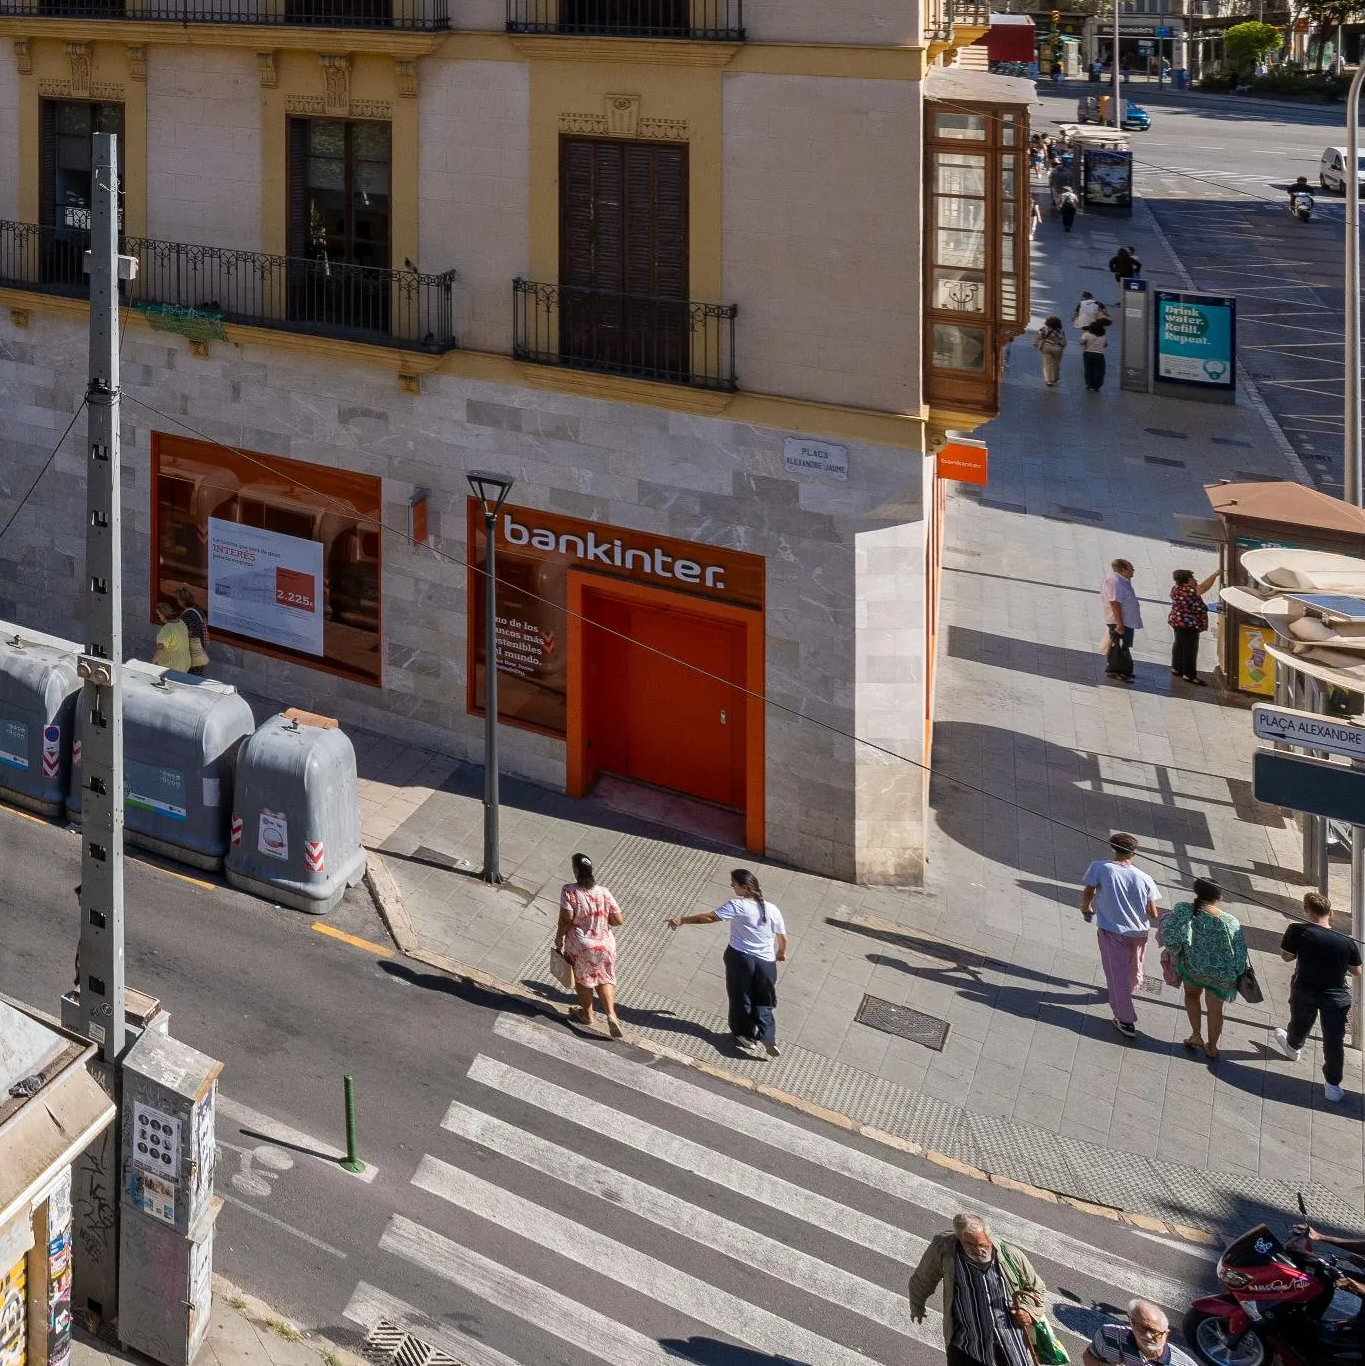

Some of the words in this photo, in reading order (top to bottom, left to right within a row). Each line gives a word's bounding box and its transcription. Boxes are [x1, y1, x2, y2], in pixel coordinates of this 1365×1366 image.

[1102, 26, 1153, 34] McDonald's
[1165, 305, 1200, 317] Drink
[1165, 314, 1205, 325] water.
[1165, 322, 1201, 334] Refill.
[1165, 331, 1211, 345] Repeat.
[824, 463, 846, 473] JAUME
[213, 543, 256, 562] INTERÉS
[503, 514, 726, 589] bankinter.
[509, 618, 521, 629] de
[523, 622, 539, 633] los
[524, 634, 545, 645] más
[505, 650, 542, 666] mundo.
[1260, 714, 1295, 732] PLAÇA
[1298, 722, 1362, 745] ALEXANDRE
